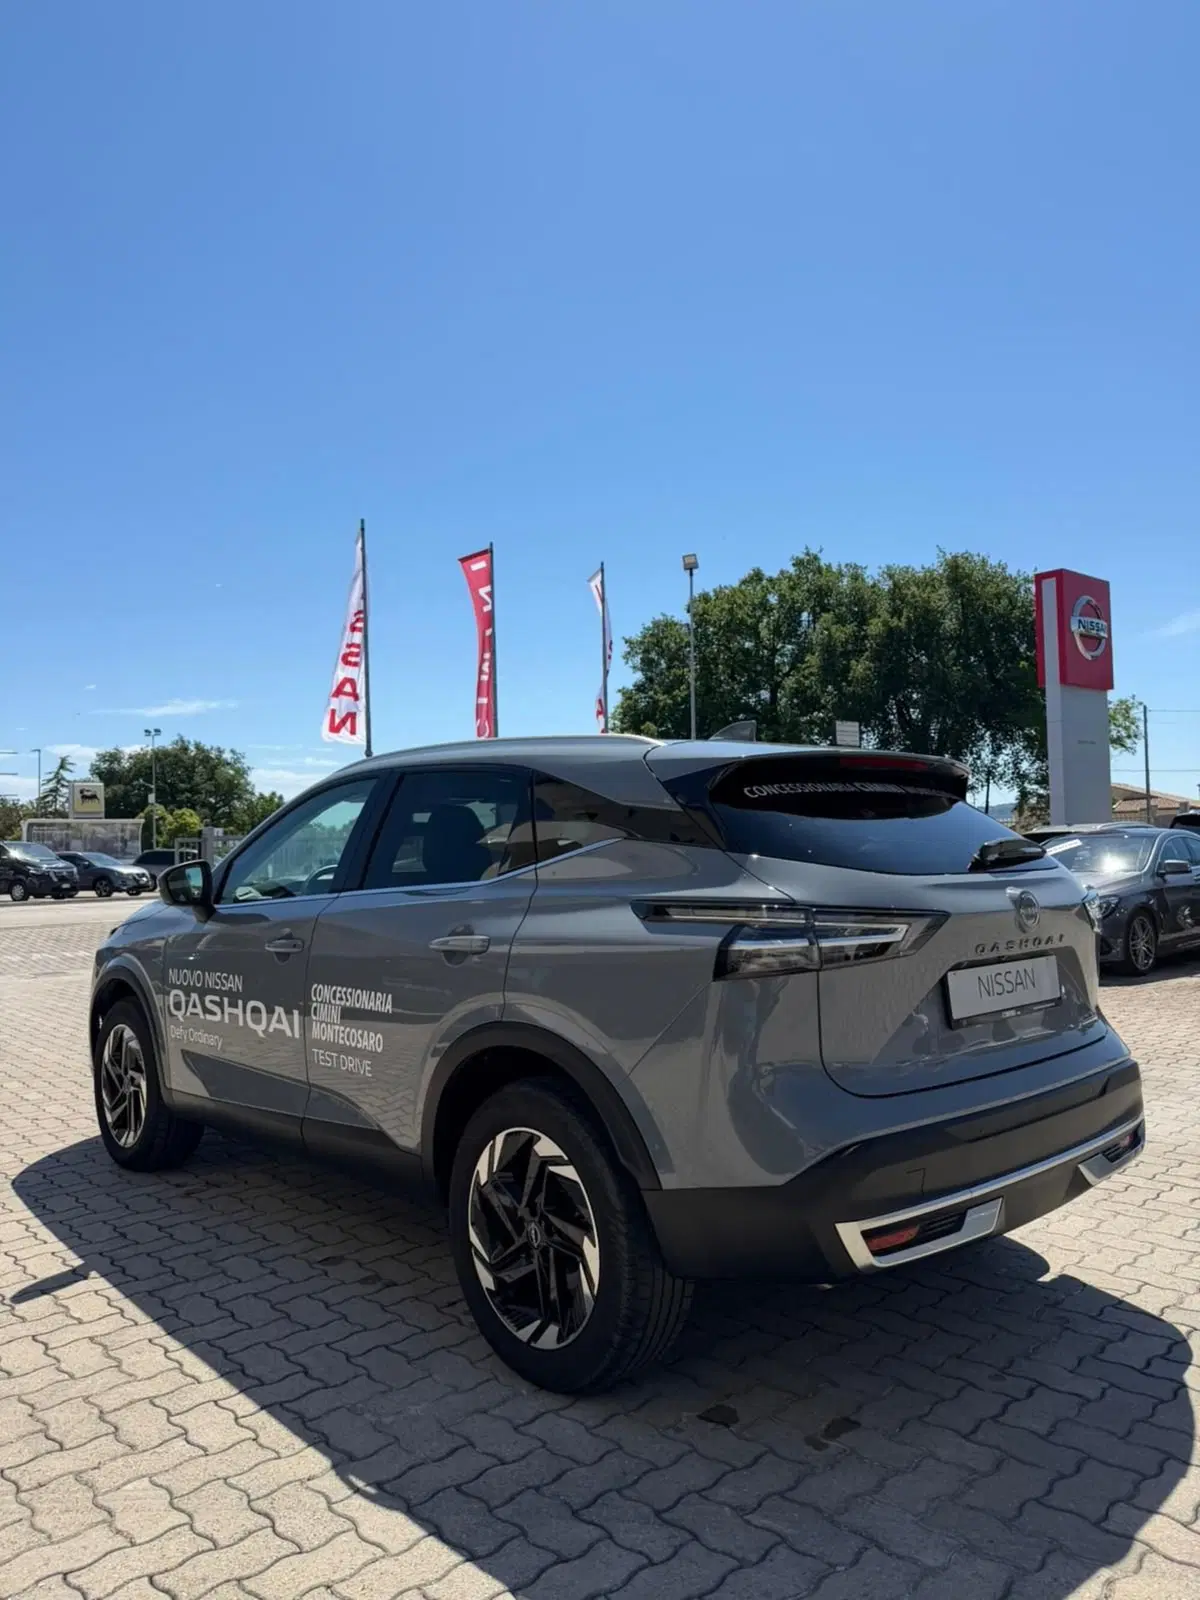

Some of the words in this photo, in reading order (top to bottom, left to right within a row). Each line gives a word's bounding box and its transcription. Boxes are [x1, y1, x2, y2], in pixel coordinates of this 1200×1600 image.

[1077, 618, 1107, 634] NISSA
[168, 968, 203, 987] NUOVO
[204, 971, 243, 993] NISSAN
[977, 967, 1036, 999] NISSAN
[169, 988, 300, 1038] QASHQAI
[311, 983, 393, 1014] CONCESSIONARIA
[311, 1003, 341, 1023] CIMINI
[169, 1025, 189, 1044] Defy
[189, 1028, 224, 1050] Ordinary
[311, 1020, 384, 1053] MONTECOSARO
[312, 1048, 338, 1069] TEST
[339, 1055, 373, 1077] DRIVE
